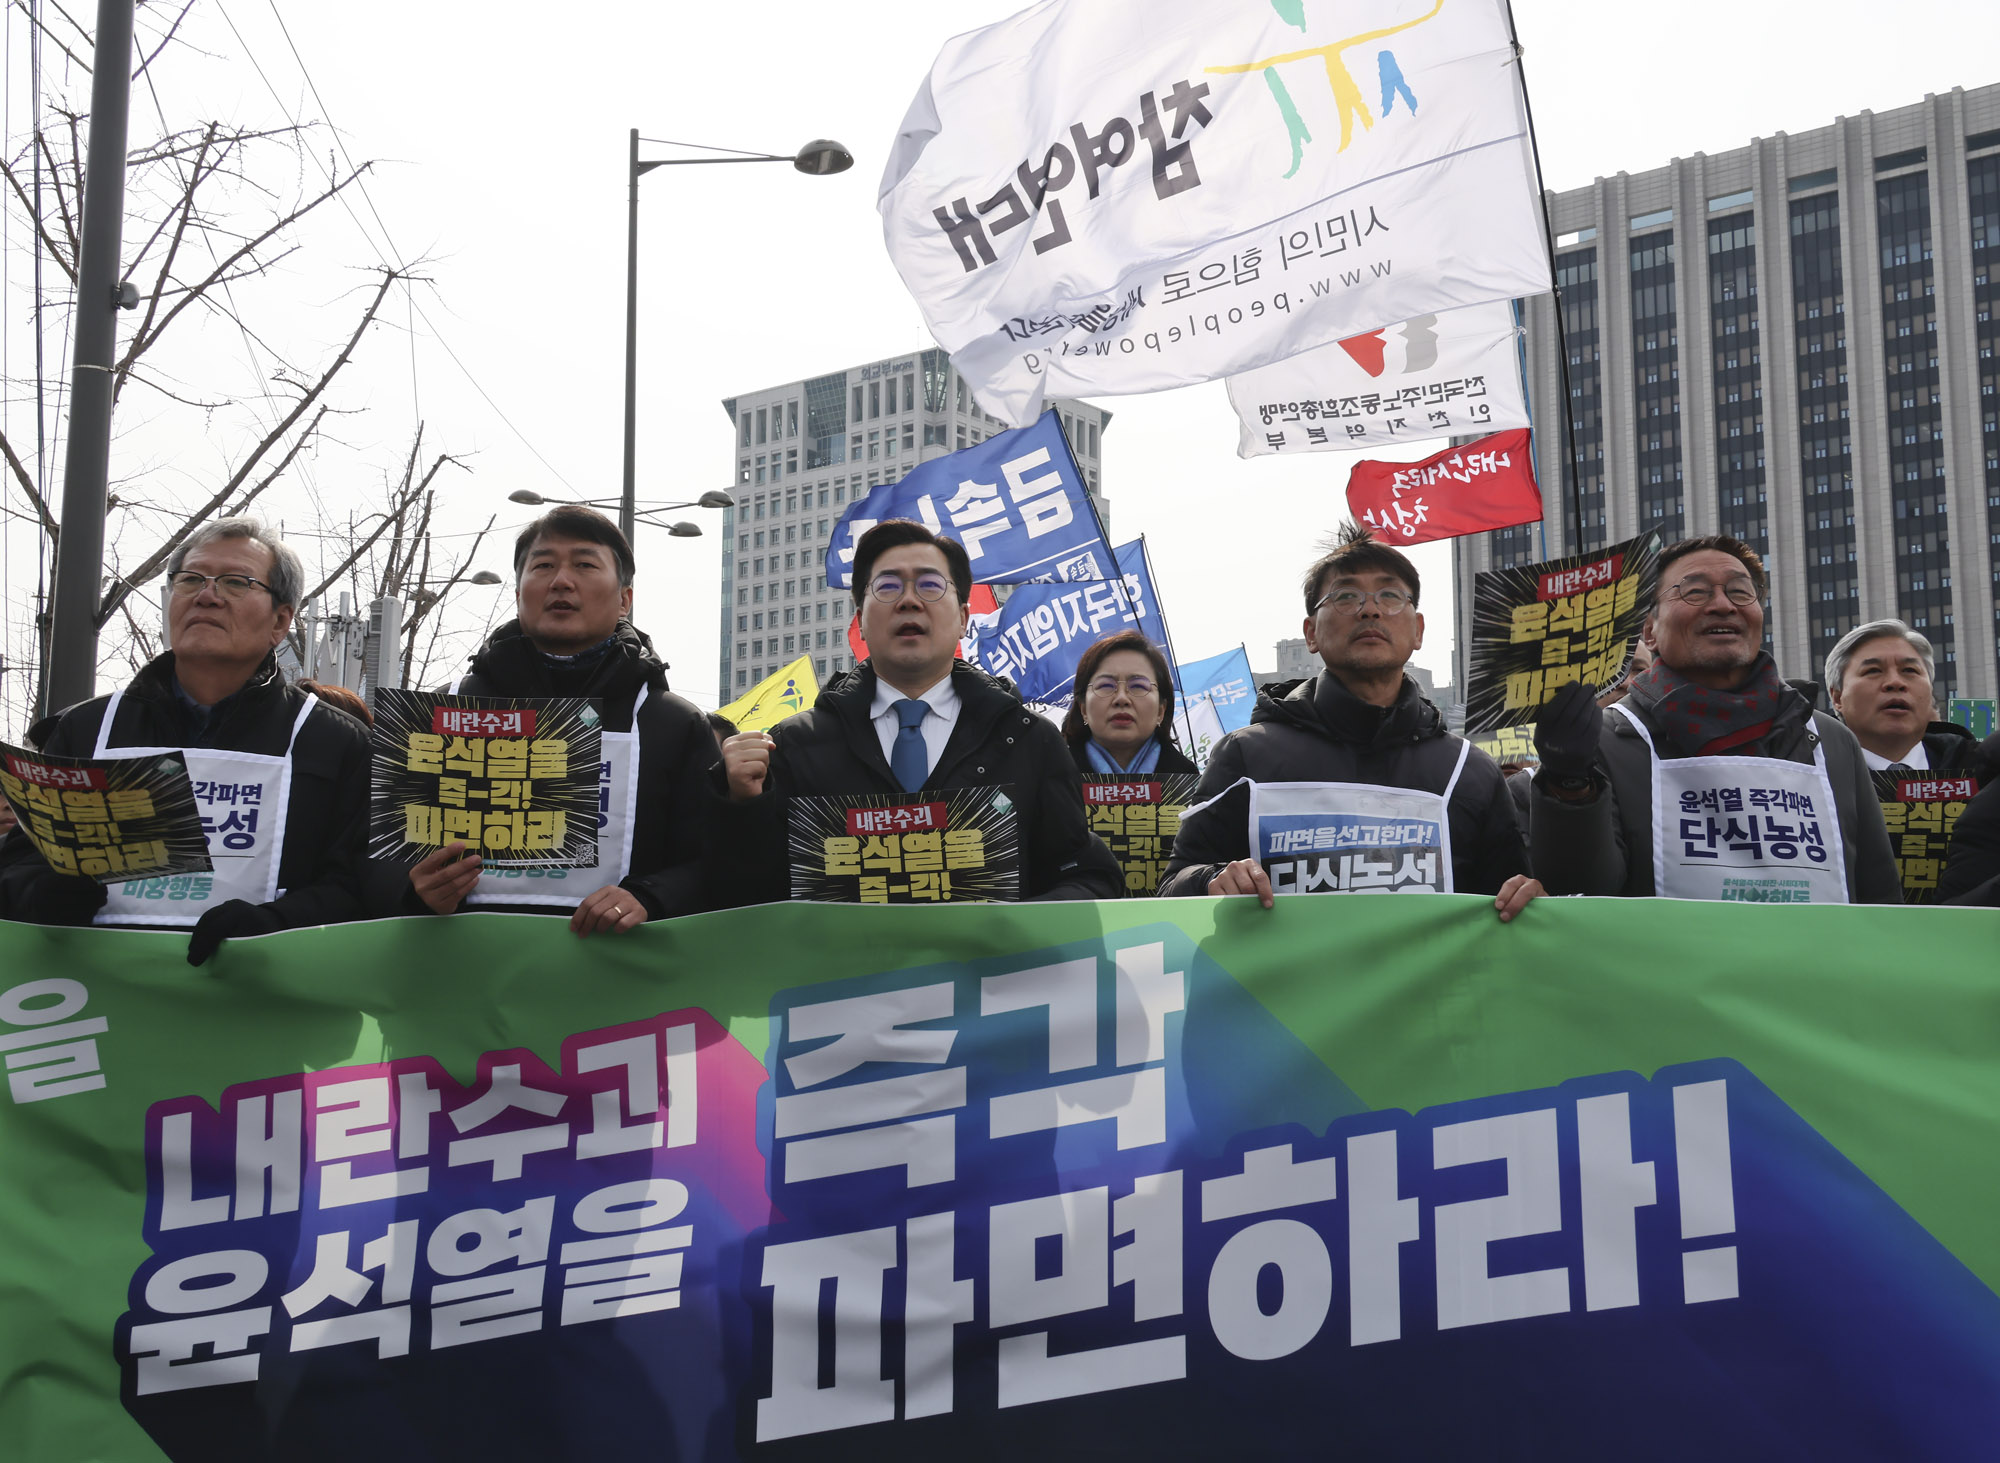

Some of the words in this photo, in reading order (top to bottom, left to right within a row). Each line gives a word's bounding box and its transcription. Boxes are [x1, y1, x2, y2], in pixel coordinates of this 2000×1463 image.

[1547, 560, 1613, 595] 내란수괴
[1509, 573, 1640, 644] 윤석열을
[442, 711, 522, 733] 내란수괴
[13, 760, 92, 787] 내란수괴
[407, 732, 568, 779] 윤석열을
[190, 780, 263, 806] 각파면
[1089, 783, 1150, 802] 내란수괴
[1679, 787, 1744, 814] 윤석열
[1749, 788, 1816, 818] 즉각파면
[1906, 780, 1971, 799] 내란수괴
[405, 803, 567, 849] 파면하라
[855, 805, 933, 831] 내란수괴
[1086, 804, 1189, 836] 석열을
[1680, 815, 1827, 862] 단식농성
[36, 838, 170, 876] 면하라
[824, 828, 985, 876] 윤석열을
[0, 978, 108, 1104] 을
[775, 940, 1185, 1189] 즉각
[159, 1023, 697, 1231] 내란수괴
[756, 1078, 1740, 1444] 파면하라!
[129, 1179, 694, 1397] 윤석열을
